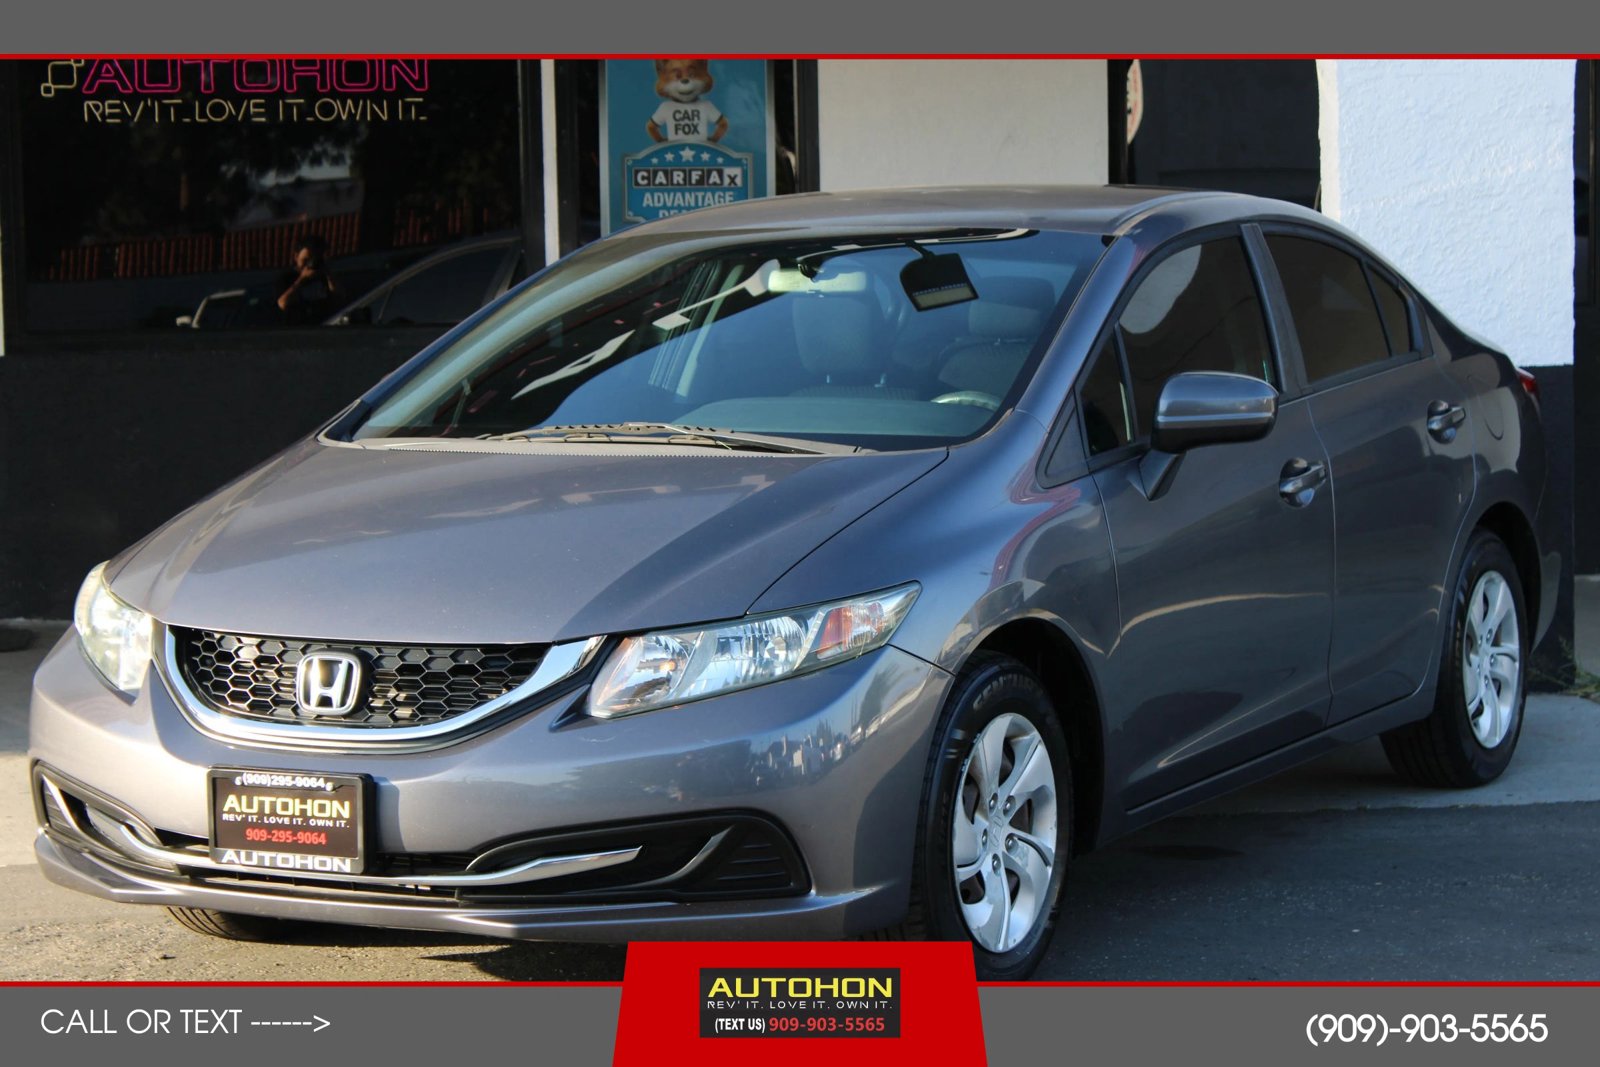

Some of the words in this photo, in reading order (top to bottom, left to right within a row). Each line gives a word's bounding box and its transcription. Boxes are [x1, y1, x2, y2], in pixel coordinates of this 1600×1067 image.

[82, 59, 428, 93] AUTOHON
[672, 109, 701, 122] CAR
[674, 123, 700, 135] FOX
[635, 169, 740, 187] CARFAX
[643, 191, 734, 207] ADVANTAGE
[222, 794, 350, 819] AUTOHON
[264, 816, 290, 825] LOVE
[309, 818, 333, 827] OWN
[245, 828, 327, 845] 909-295-9064
[221, 850, 351, 873] AUTOHON
